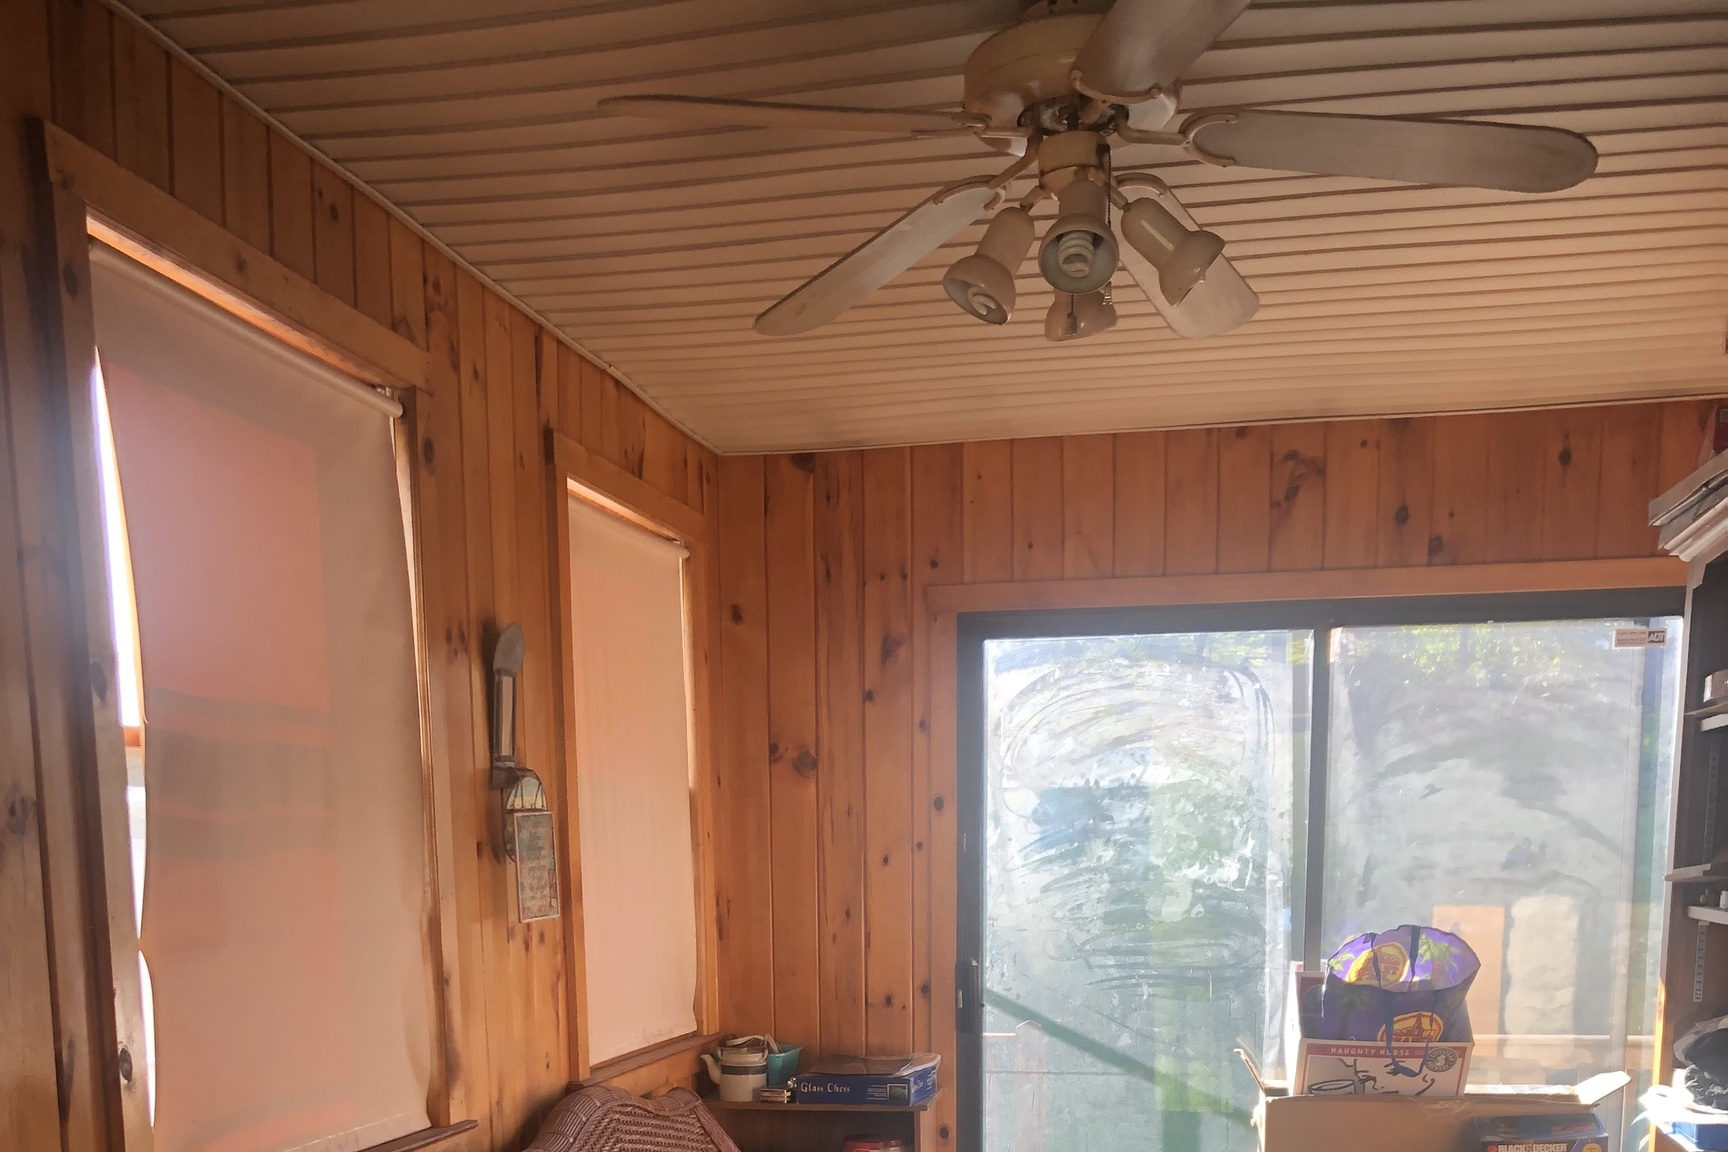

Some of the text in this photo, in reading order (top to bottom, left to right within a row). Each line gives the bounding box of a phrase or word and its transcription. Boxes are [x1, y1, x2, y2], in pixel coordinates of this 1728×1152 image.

[1648, 632, 1665, 642] ADT
[1330, 1047, 1376, 1055] NAUGHTY
[800, 1081, 851, 1093] Glass Chess
